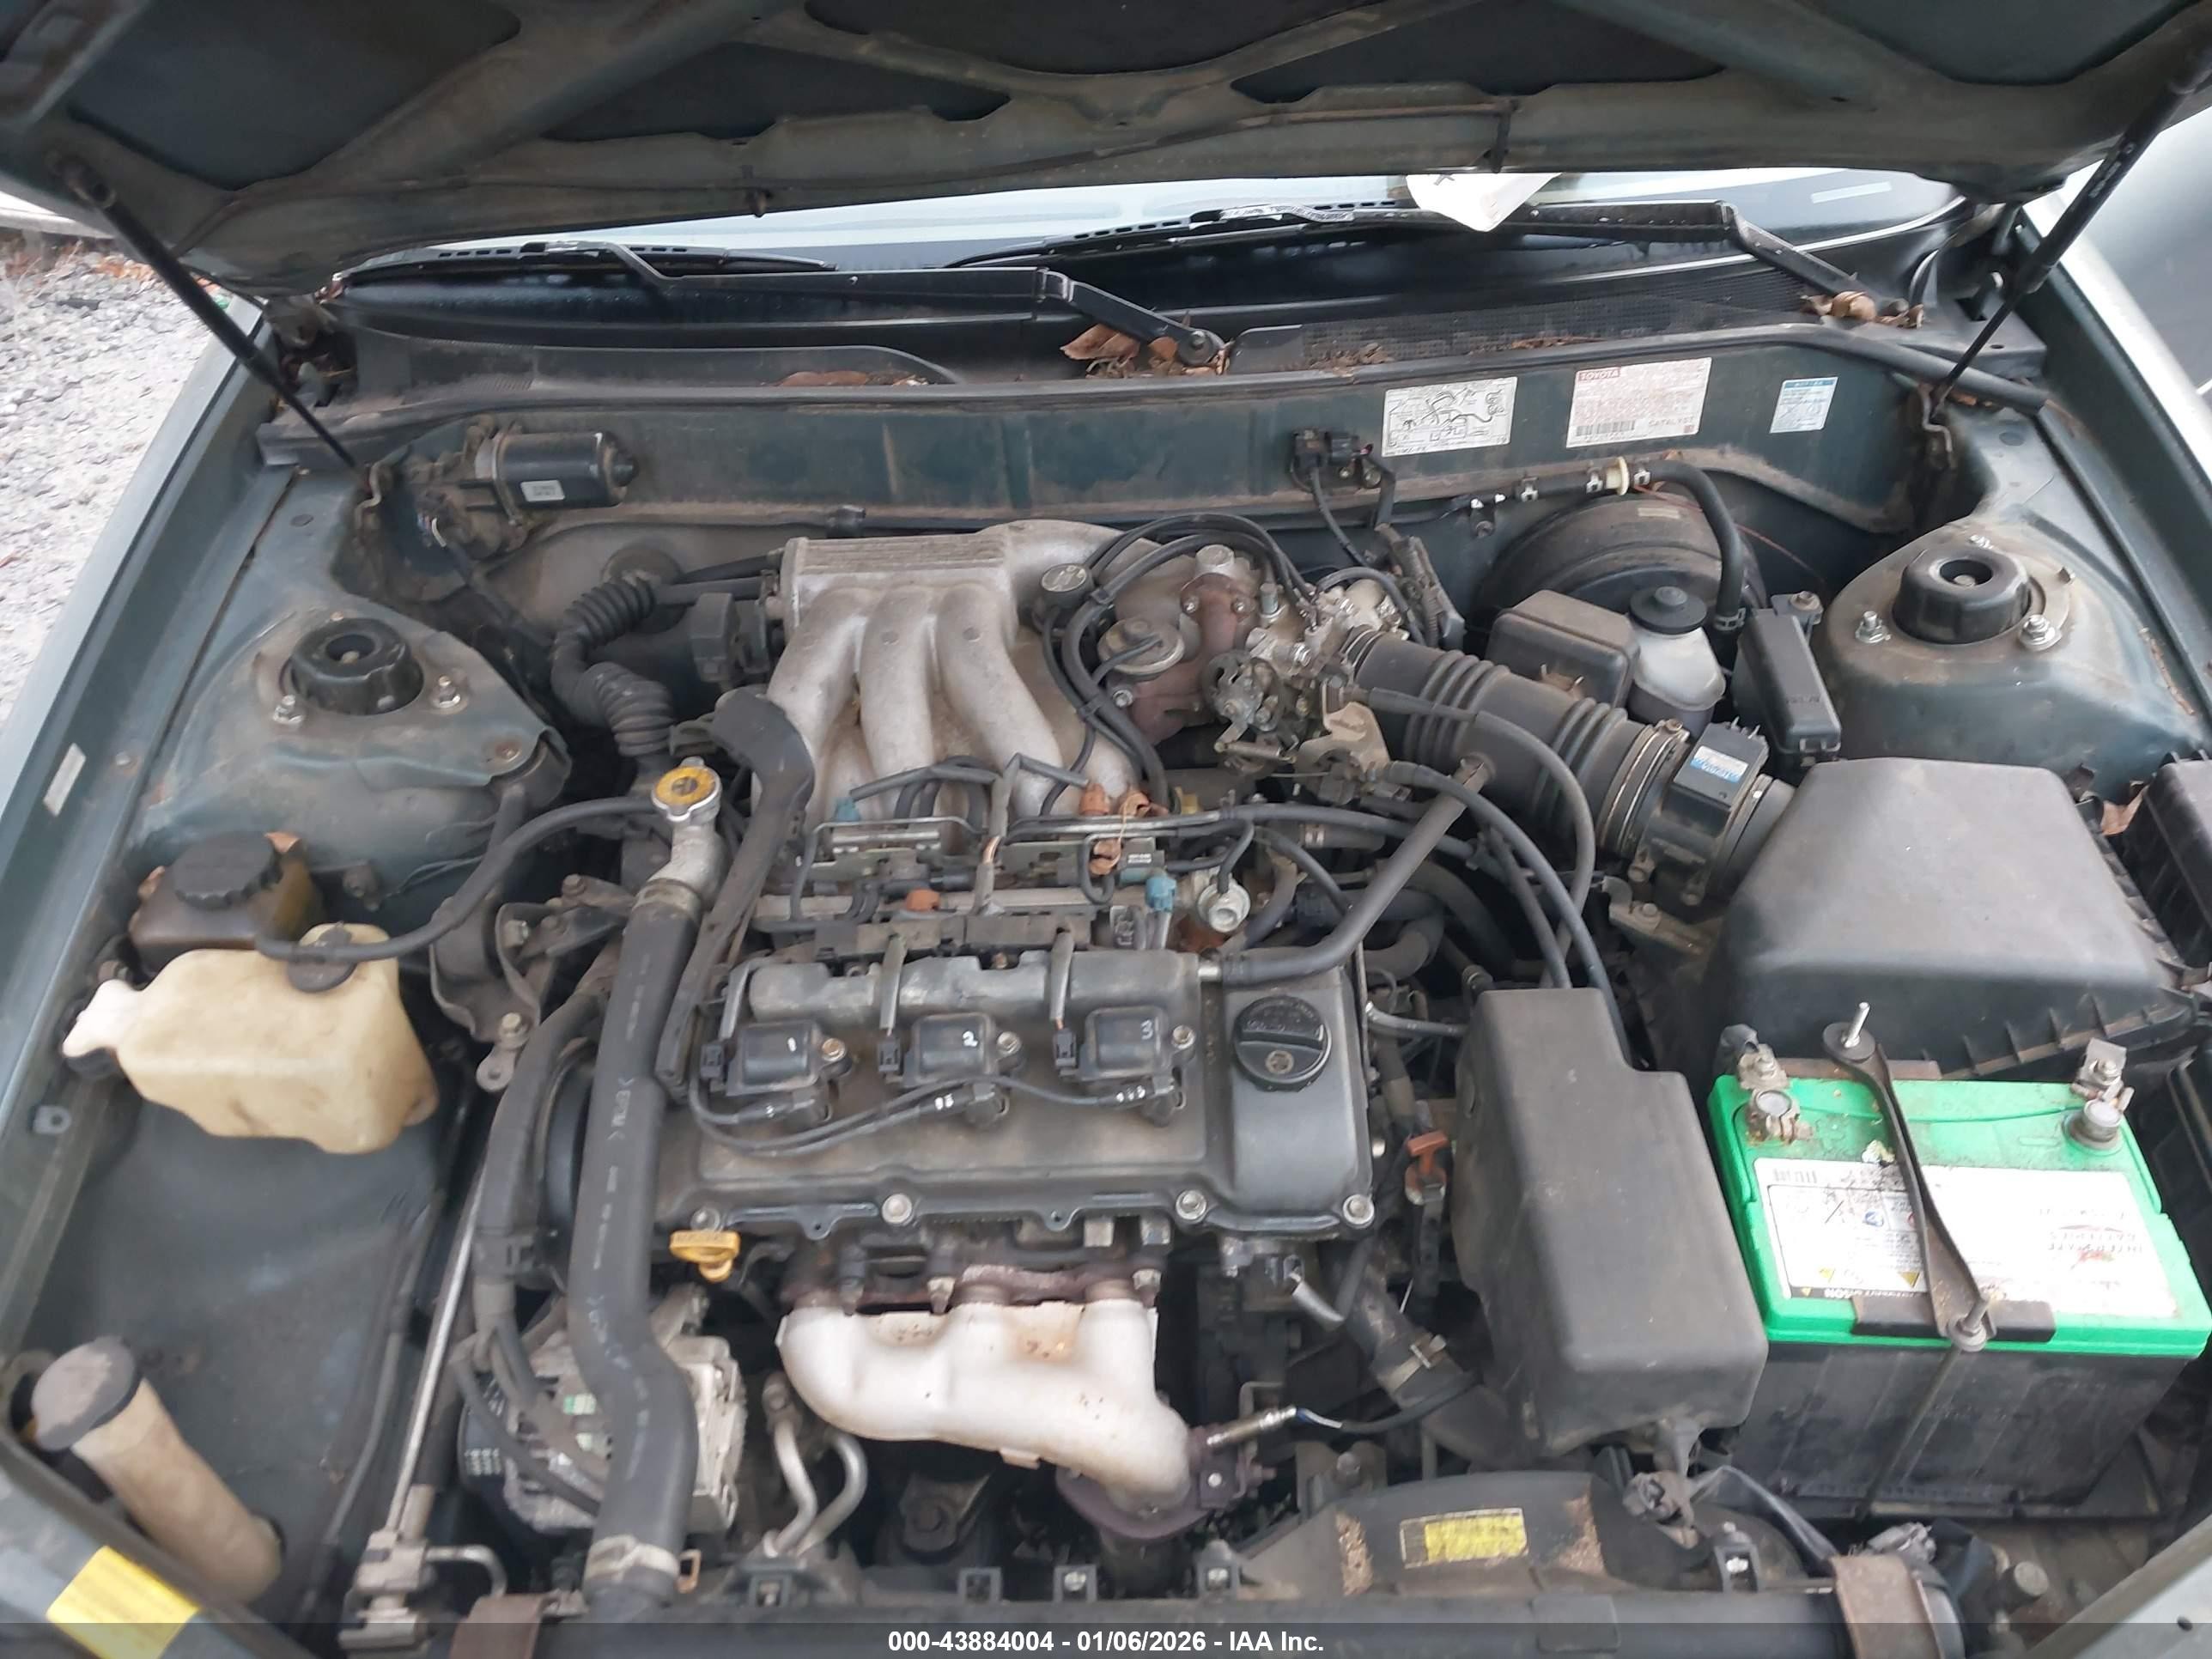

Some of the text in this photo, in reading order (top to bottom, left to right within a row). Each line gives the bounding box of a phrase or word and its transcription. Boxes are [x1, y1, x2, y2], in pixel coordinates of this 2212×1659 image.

[1580, 369, 1619, 380] TOYOTA
[1648, 416, 1695, 427] CATALYST
[1140, 1019, 1154, 1040] 3
[962, 1030, 978, 1048] 2
